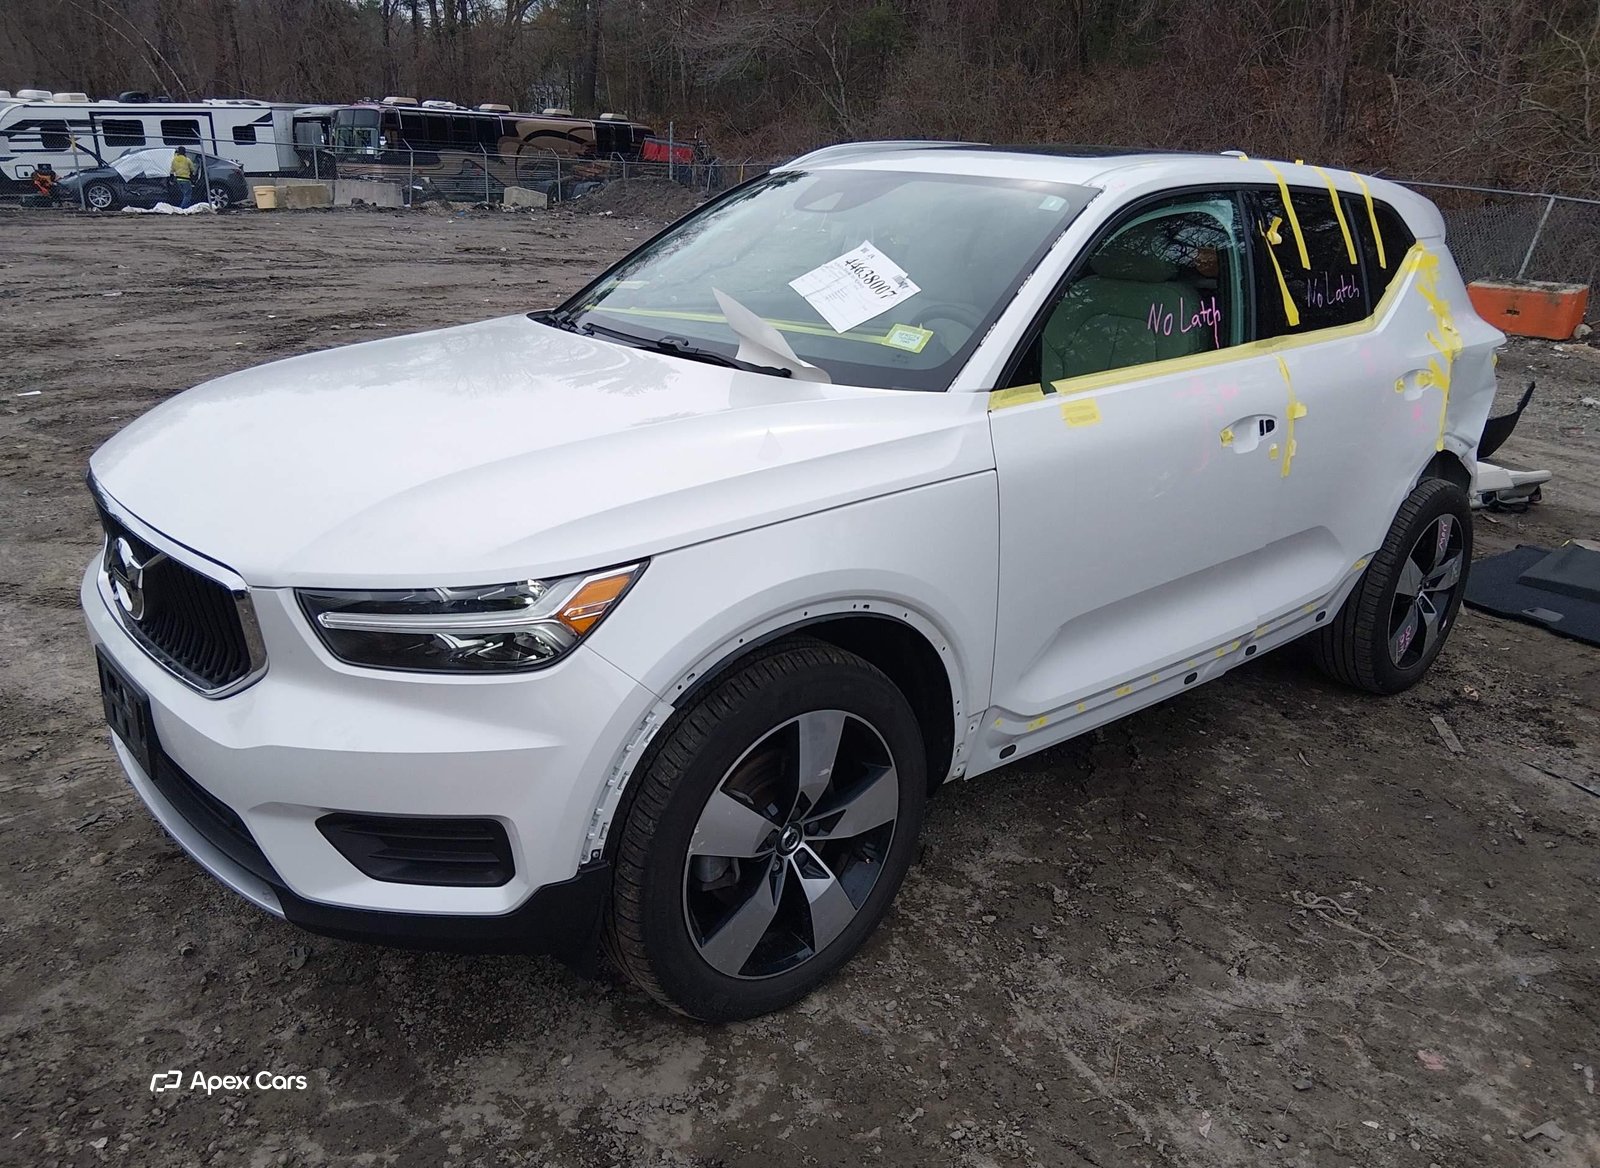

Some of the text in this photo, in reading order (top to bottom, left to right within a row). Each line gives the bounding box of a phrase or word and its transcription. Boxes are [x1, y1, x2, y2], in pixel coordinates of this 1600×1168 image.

[844, 258, 898, 300] 44638007
[1307, 271, 1360, 308] No Latch
[1147, 296, 1221, 349] No Latch
